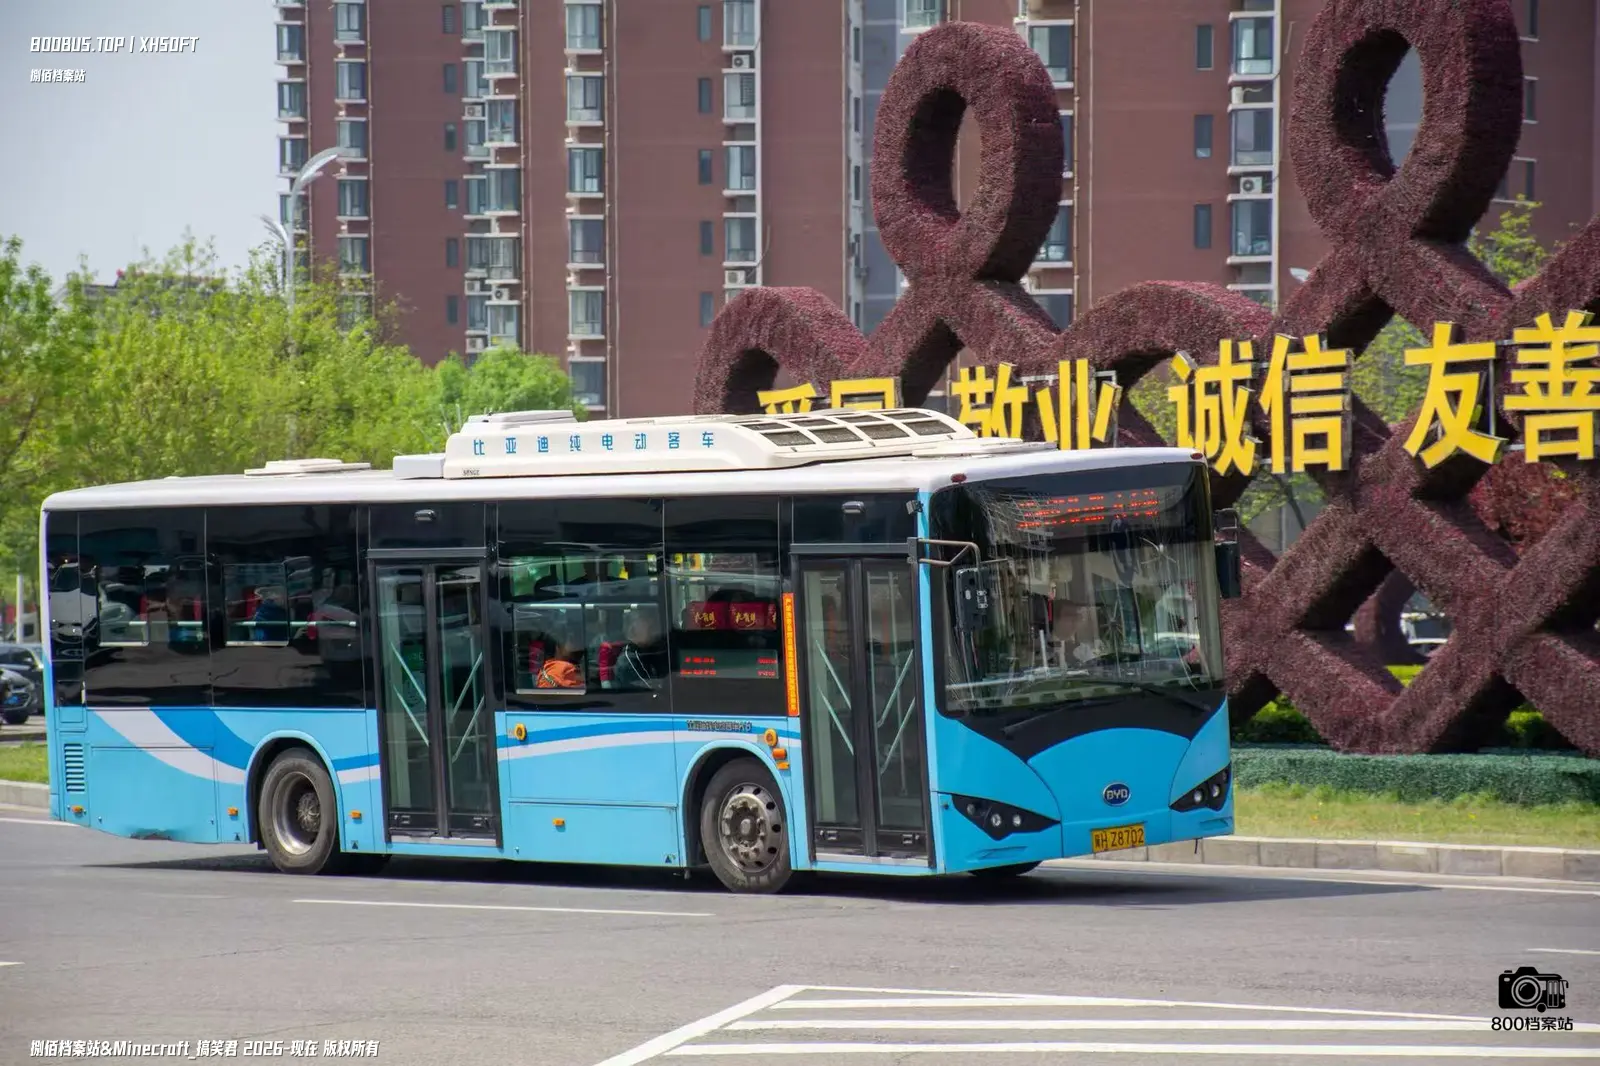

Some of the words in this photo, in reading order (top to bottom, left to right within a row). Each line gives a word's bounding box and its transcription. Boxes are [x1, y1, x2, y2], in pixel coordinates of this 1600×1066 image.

[1167, 332, 1353, 476] 诚信
[1403, 309, 1600, 469] 友善
[473, 431, 715, 456] 比亚迪纯电动客车
[1106, 788, 1128, 800] BYD
